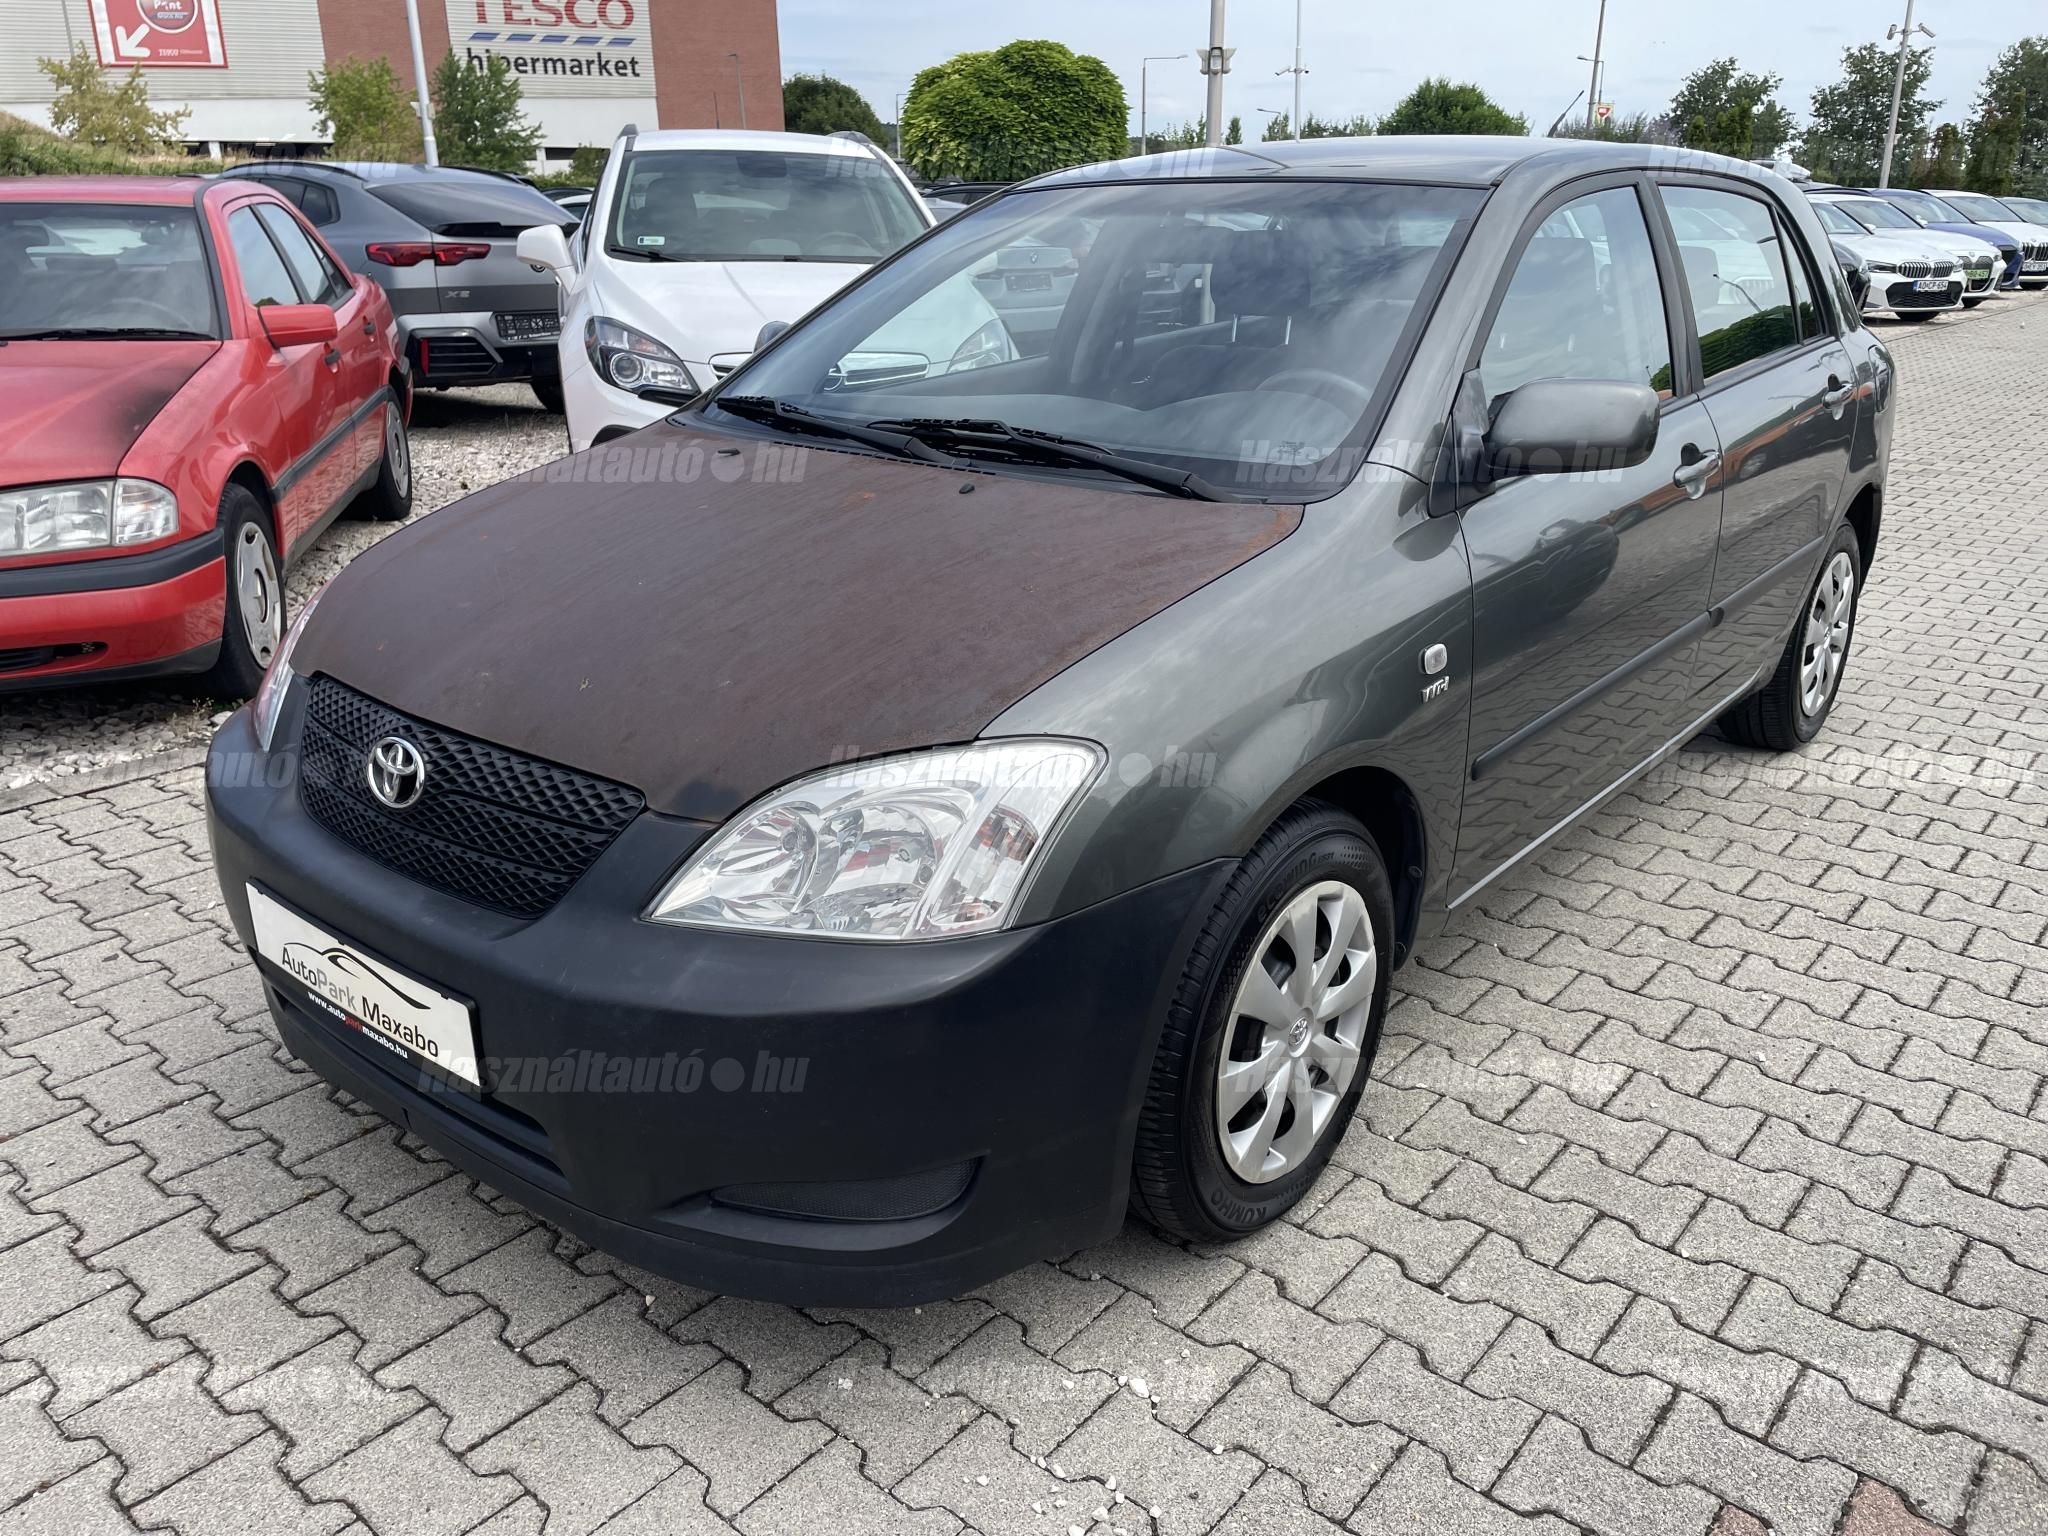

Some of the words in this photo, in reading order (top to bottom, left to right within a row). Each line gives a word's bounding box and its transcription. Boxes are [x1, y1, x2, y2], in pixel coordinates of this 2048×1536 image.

[475, 0, 634, 29] TESCO
[281, 946, 358, 1012] AutoPark
[361, 995, 439, 1058] Maxabo
[307, 990, 409, 1060] www.autoparkmaxabo.hu
[1210, 1188, 1267, 1224] KUMHO
